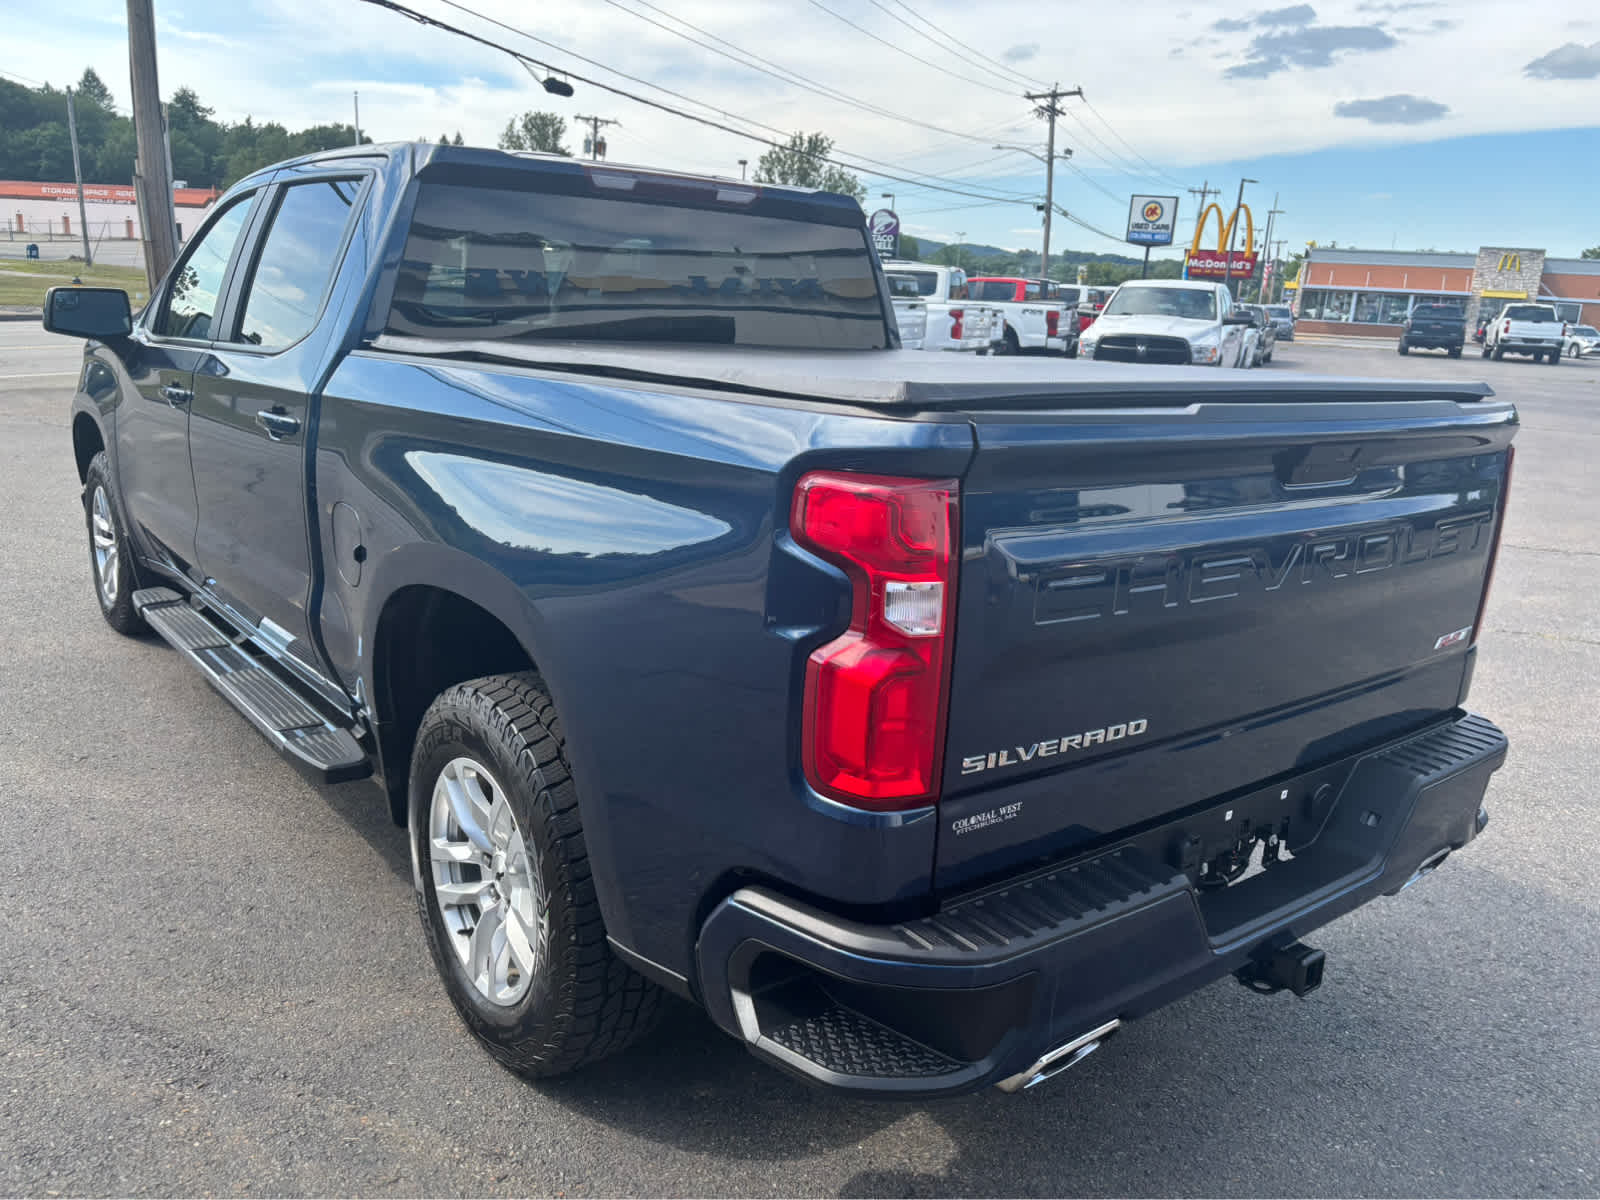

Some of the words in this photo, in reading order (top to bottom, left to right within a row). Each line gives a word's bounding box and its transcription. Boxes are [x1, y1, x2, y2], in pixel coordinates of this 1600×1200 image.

[1033, 510, 1492, 625] CHEVROLET
[961, 718, 1148, 775] SILVERADO
[952, 809, 998, 831] COLONIAL
[999, 801, 1023, 816] WEST
